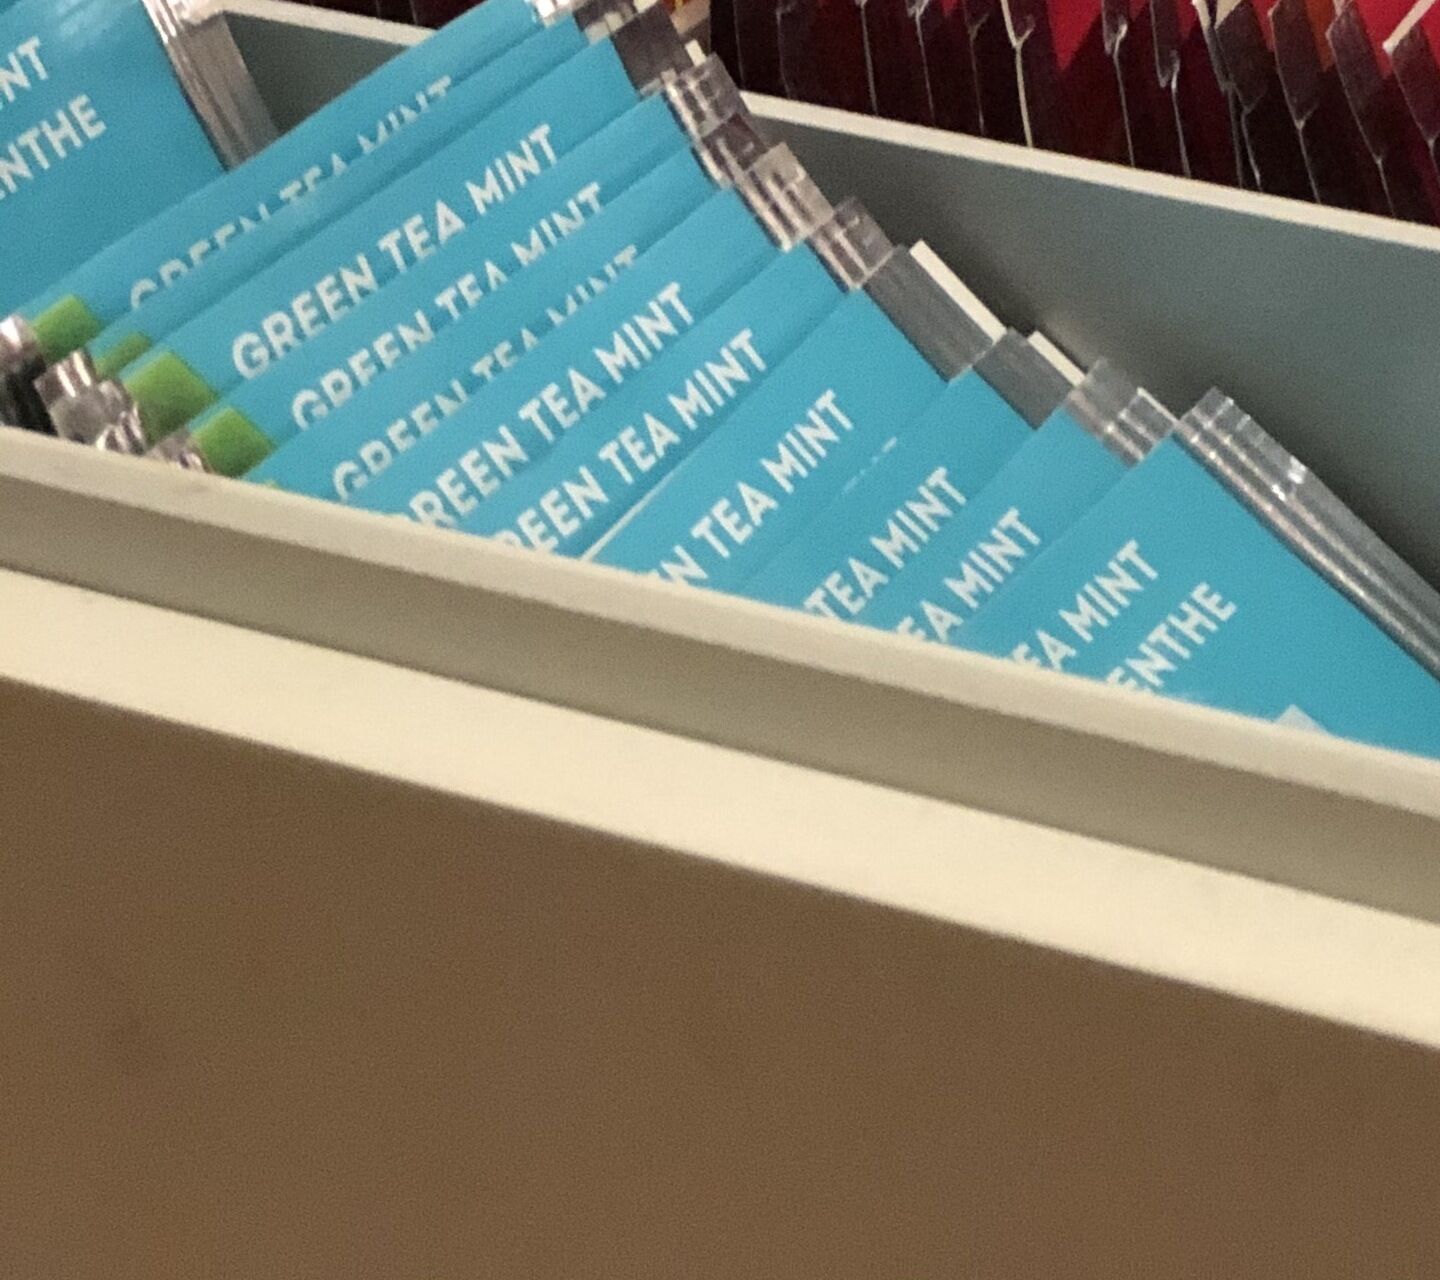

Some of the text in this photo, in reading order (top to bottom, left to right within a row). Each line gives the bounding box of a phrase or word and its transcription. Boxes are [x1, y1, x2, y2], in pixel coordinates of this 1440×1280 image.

[232, 123, 559, 380] GREEN TEA MINT
[291, 182, 603, 429] GREEN TEA MINT
[518, 367, 606, 442] TEA
[593, 282, 694, 383] MINT
[598, 412, 681, 484] TEA
[667, 328, 766, 430] MINT
[691, 481, 780, 559] TEA
[760, 389, 853, 493] MINT
[803, 467, 967, 619] TEA MINT
[943, 507, 1042, 610] MINT
[1059, 538, 1159, 643] MINT
